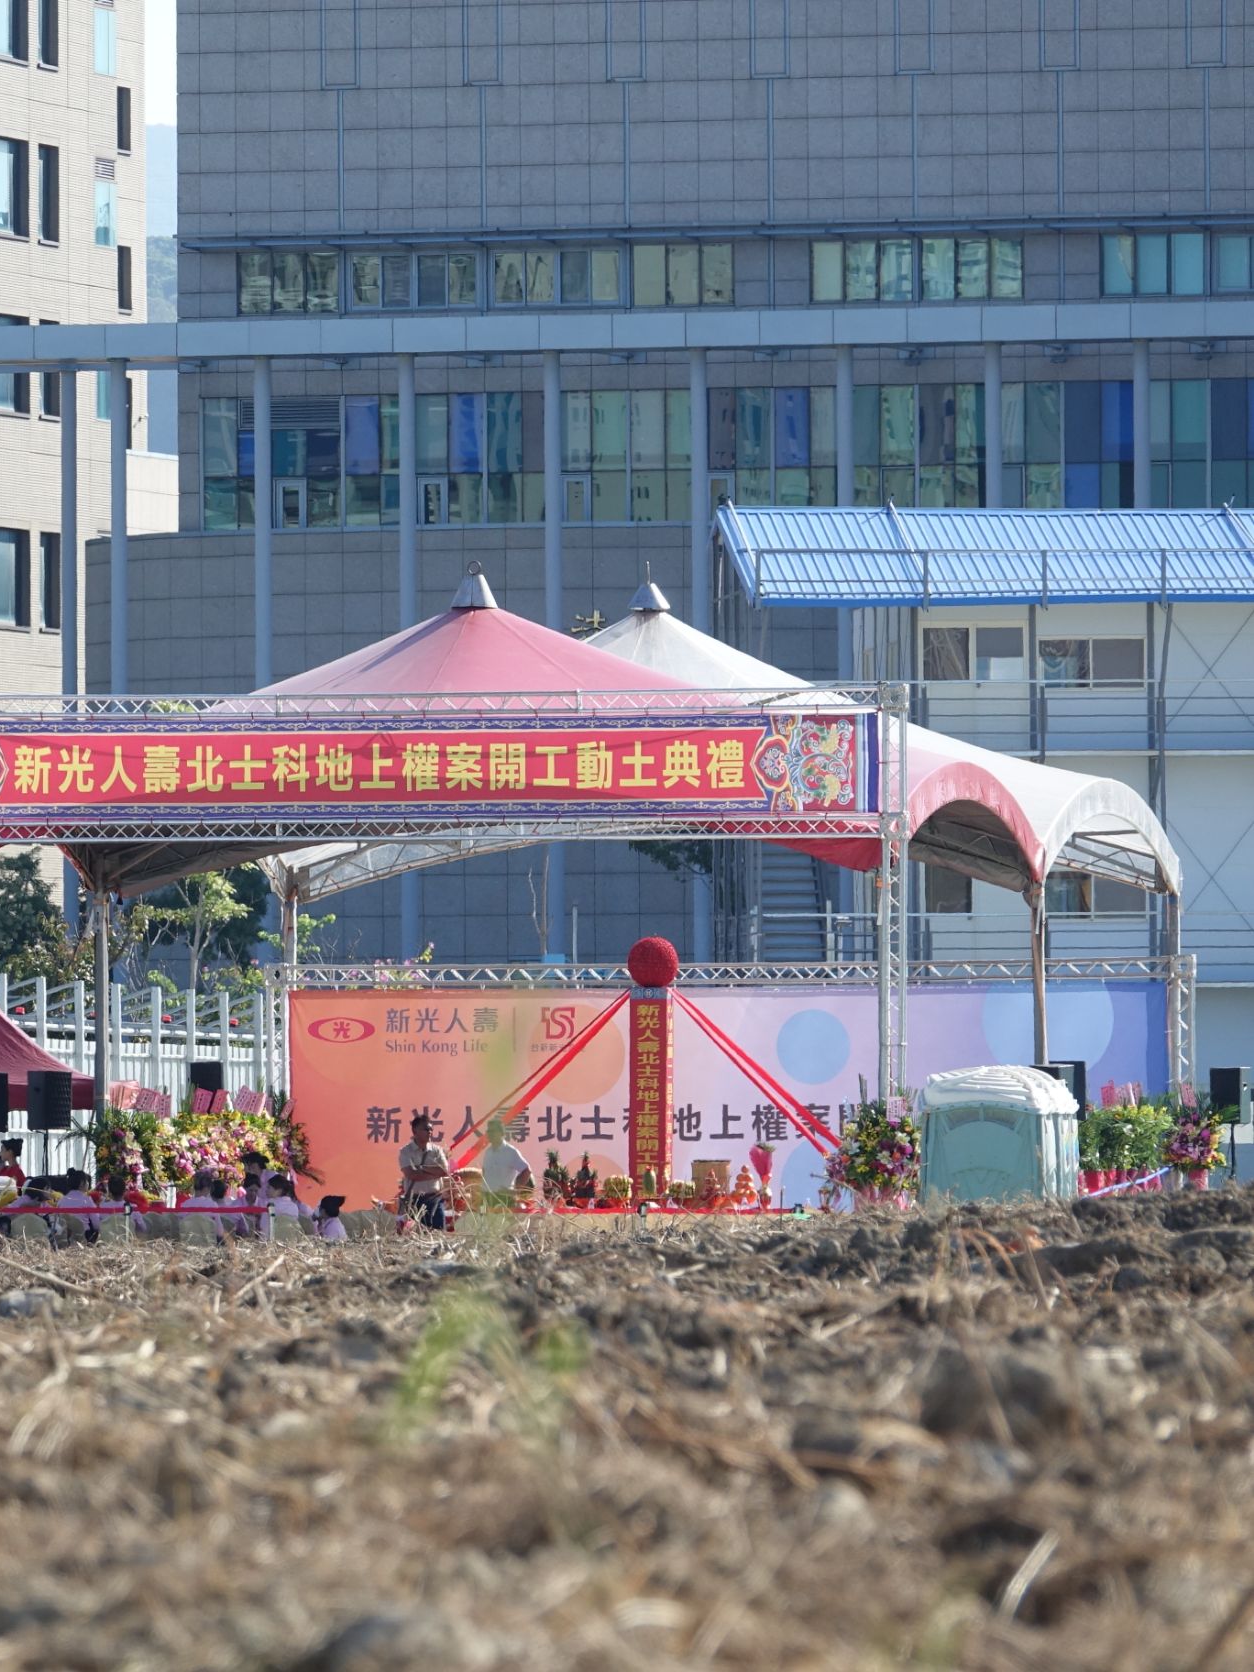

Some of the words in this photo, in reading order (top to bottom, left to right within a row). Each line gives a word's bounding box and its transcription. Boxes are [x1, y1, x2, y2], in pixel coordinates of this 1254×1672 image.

[14, 740, 745, 794] 新光人壽北士科地上權案開工動土典禮
[385, 1007, 498, 1034] 新光人壽
[385, 1040, 416, 1053] Shin
[422, 1040, 458, 1057] Kong
[463, 1040, 489, 1053] Life
